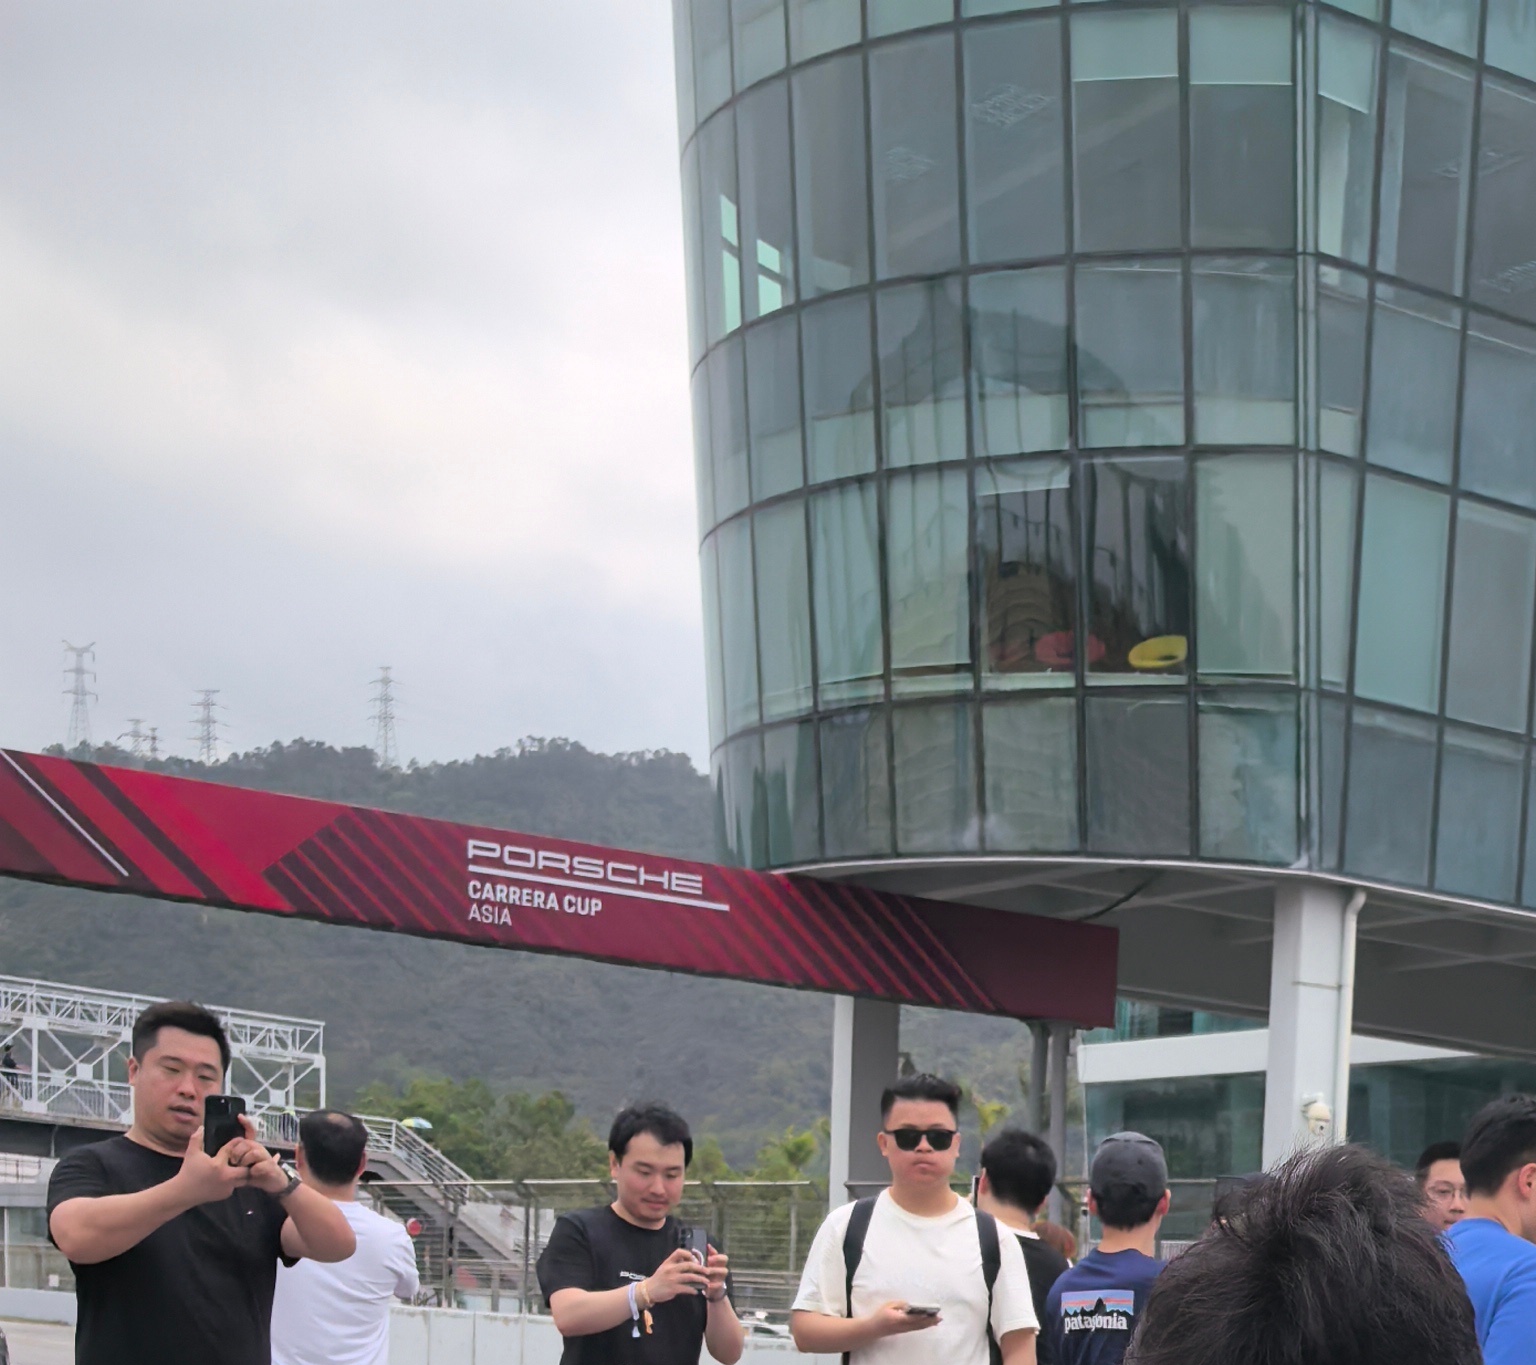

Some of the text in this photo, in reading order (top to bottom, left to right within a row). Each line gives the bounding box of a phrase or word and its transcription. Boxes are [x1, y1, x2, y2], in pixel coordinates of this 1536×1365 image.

[467, 839, 702, 895] PORSCHE
[467, 880, 602, 916] CARRERA CUP
[468, 903, 512, 926] ASIA
[1064, 1312, 1128, 1334] patagonia
